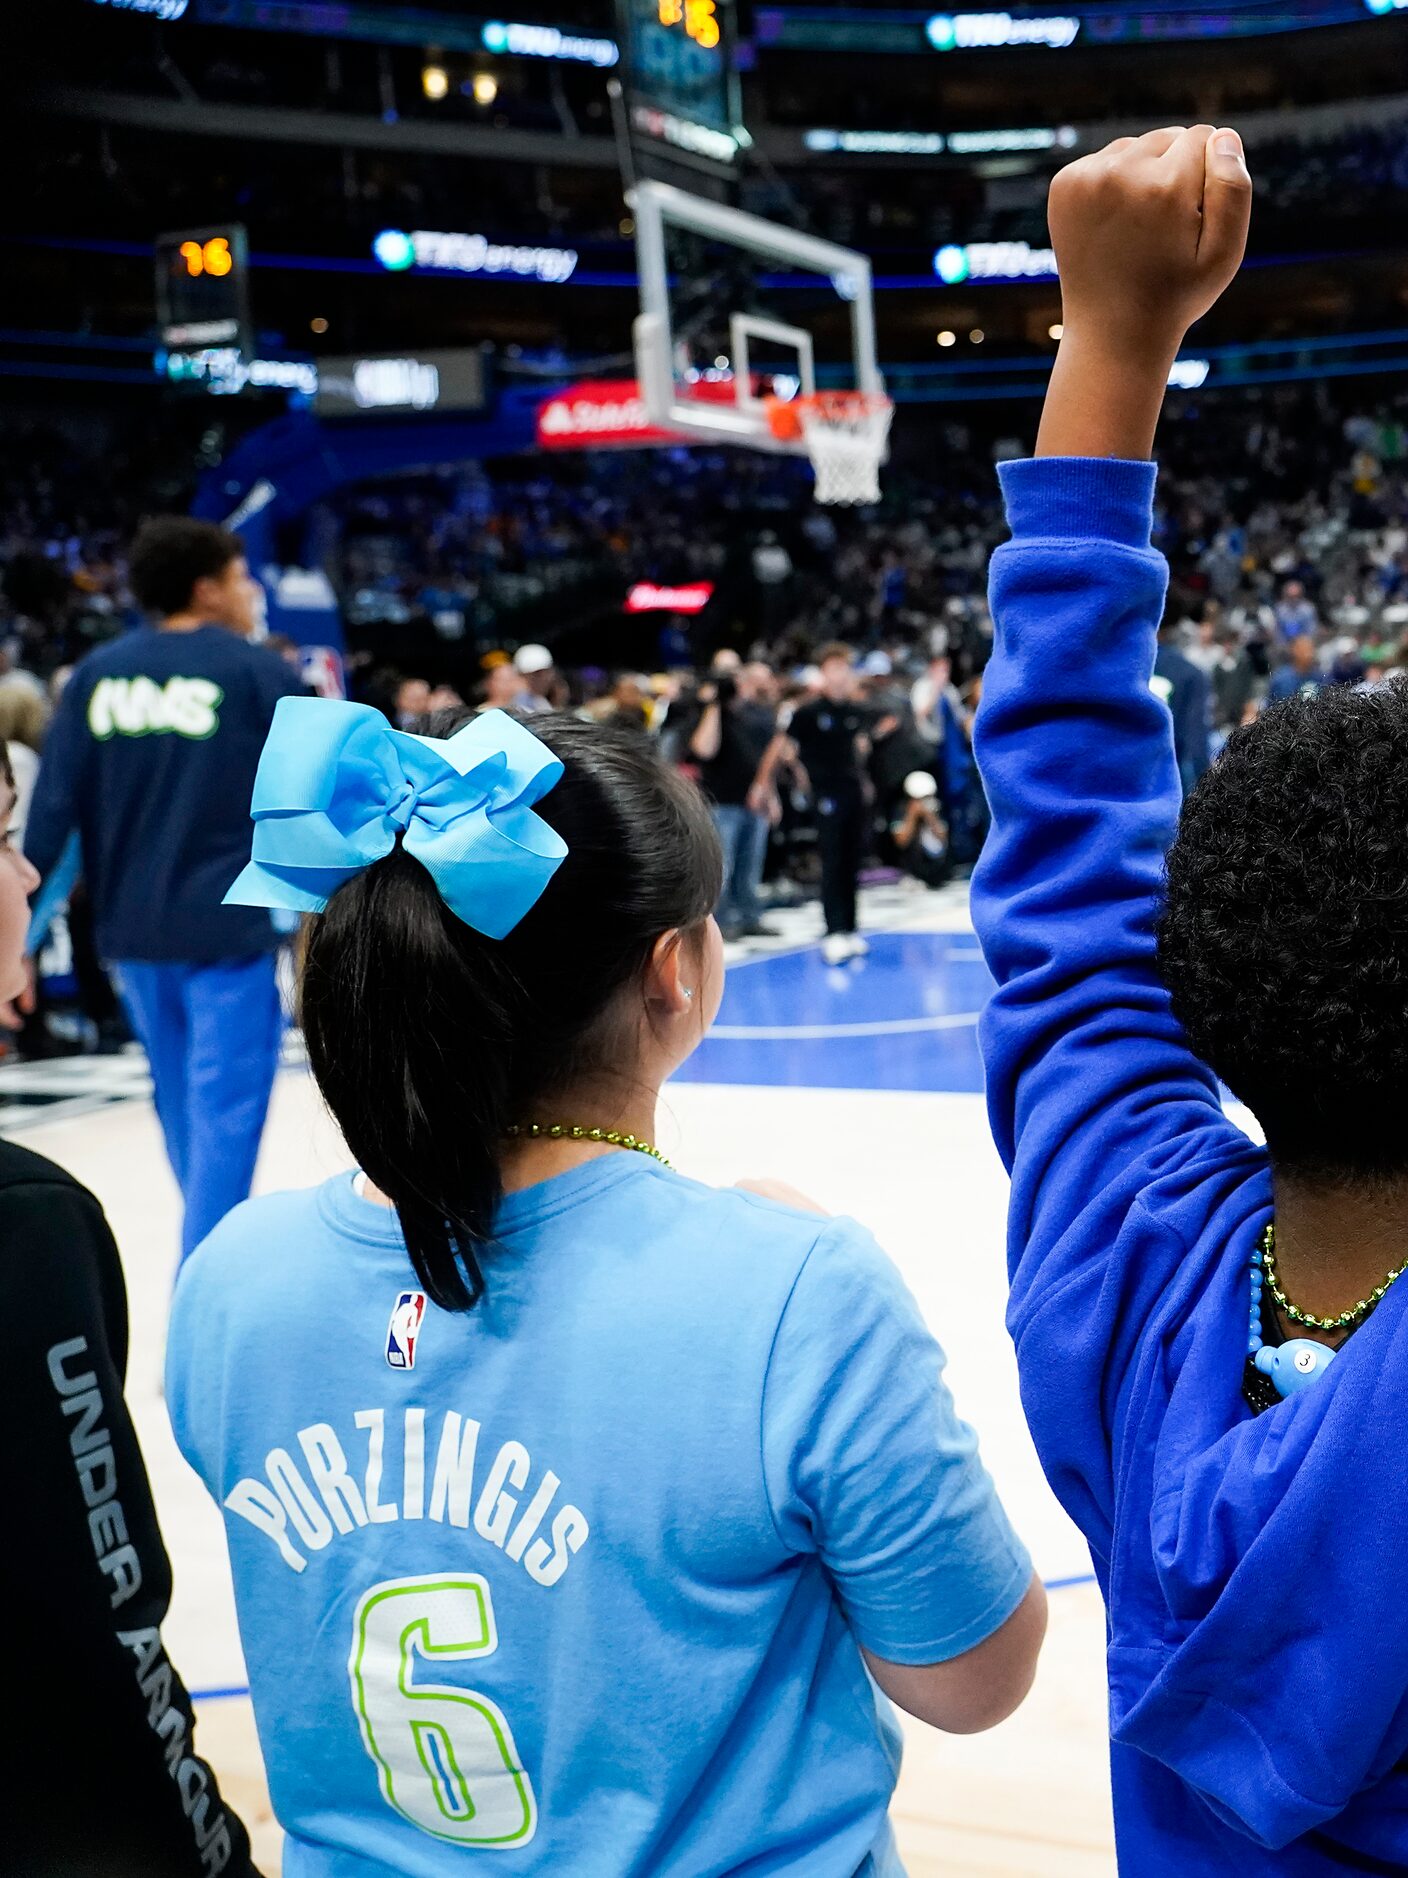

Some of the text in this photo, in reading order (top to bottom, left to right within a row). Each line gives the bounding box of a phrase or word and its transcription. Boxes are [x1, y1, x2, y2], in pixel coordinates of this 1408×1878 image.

[47, 1335, 142, 1610] UNDER
[224, 1408, 590, 1587] PORZINGIS
[115, 1626, 231, 1878] ARMOUR
[348, 1572, 538, 1850] 6
